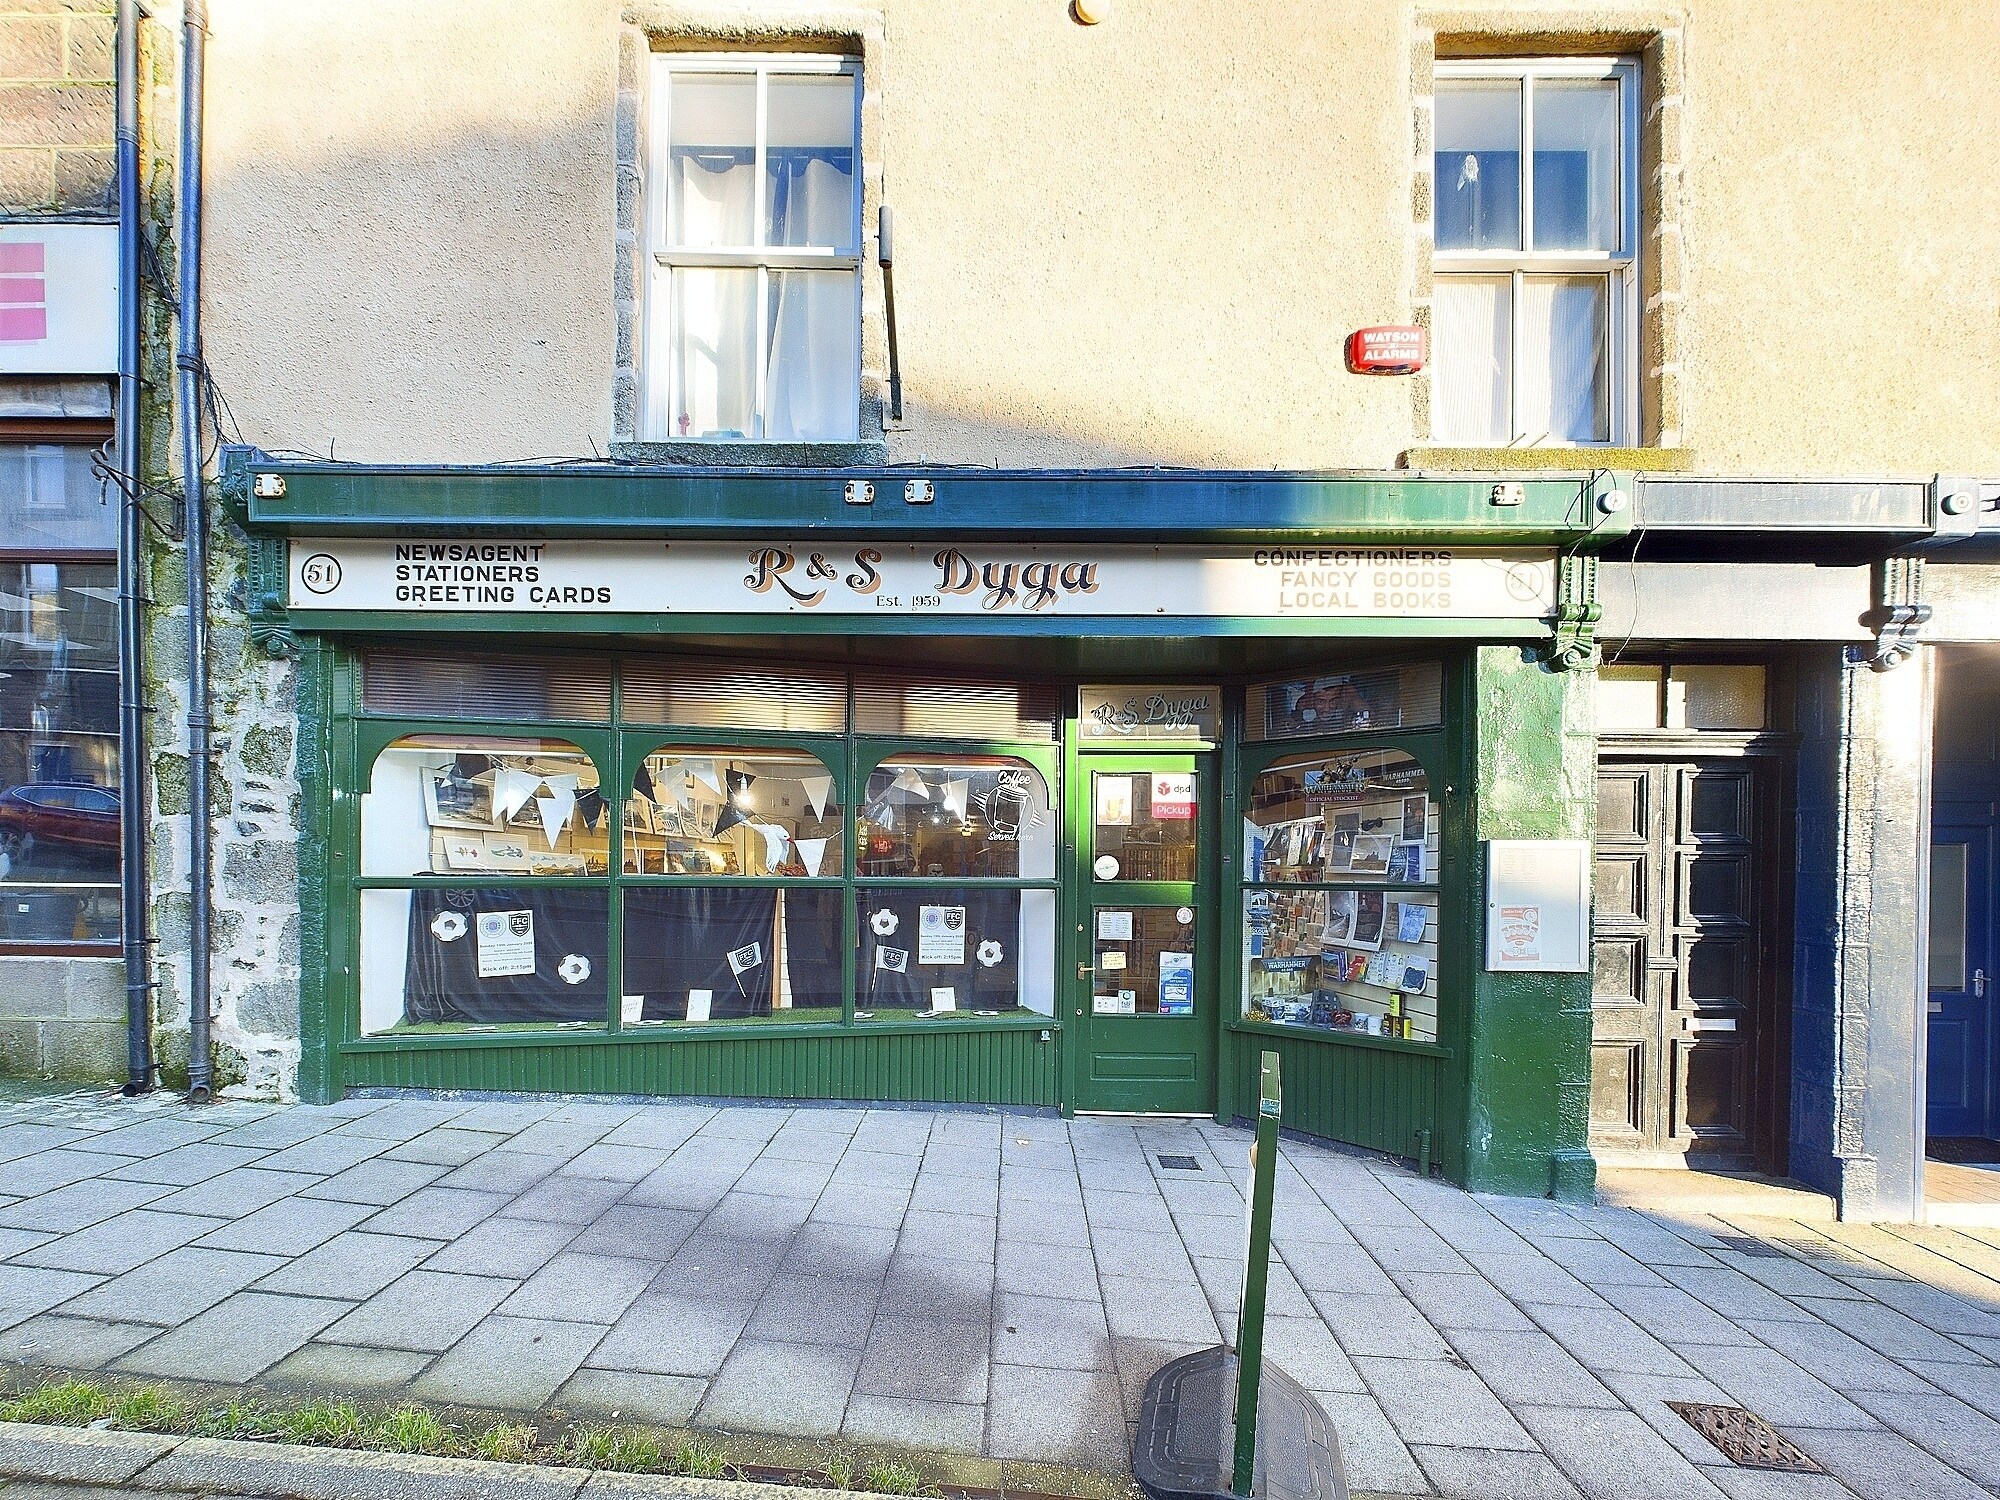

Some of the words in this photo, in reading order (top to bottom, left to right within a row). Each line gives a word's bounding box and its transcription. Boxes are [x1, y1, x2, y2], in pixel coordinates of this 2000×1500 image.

[1363, 332, 1419, 342] WATSON
[1362, 350, 1419, 361] ALARMS
[396, 544, 543, 562] NEWSAGENT
[1254, 550, 1452, 567] CONFECTIONERS
[307, 564, 335, 584] 51
[396, 565, 539, 582] STATIONERS
[743, 547, 828, 606] R
[805, 552, 838, 581] &
[845, 547, 882, 594] S
[932, 546, 1101, 611] Dyga
[1281, 571, 1358, 587] FANCY
[1373, 571, 1451, 587] GOODS
[396, 586, 515, 603] GREETING
[529, 587, 612, 603] CARDS
[876, 595, 903, 607] Est.
[911, 595, 941, 607] 1959
[1280, 592, 1359, 608] LOCAL
[1374, 592, 1451, 608] BOOKS
[1144, 692, 1210, 731] Dyga
[998, 770, 1032, 788] Coffee
[1383, 768, 1425, 781] WARHAMMER
[1174, 785, 1191, 794] dpd
[1157, 805, 1192, 815] Pickup
[987, 831, 1015, 841] Served
[511, 917, 528, 926] FFC
[946, 912, 961, 920] FFC
[1268, 961, 1306, 970] WARHAMMER
